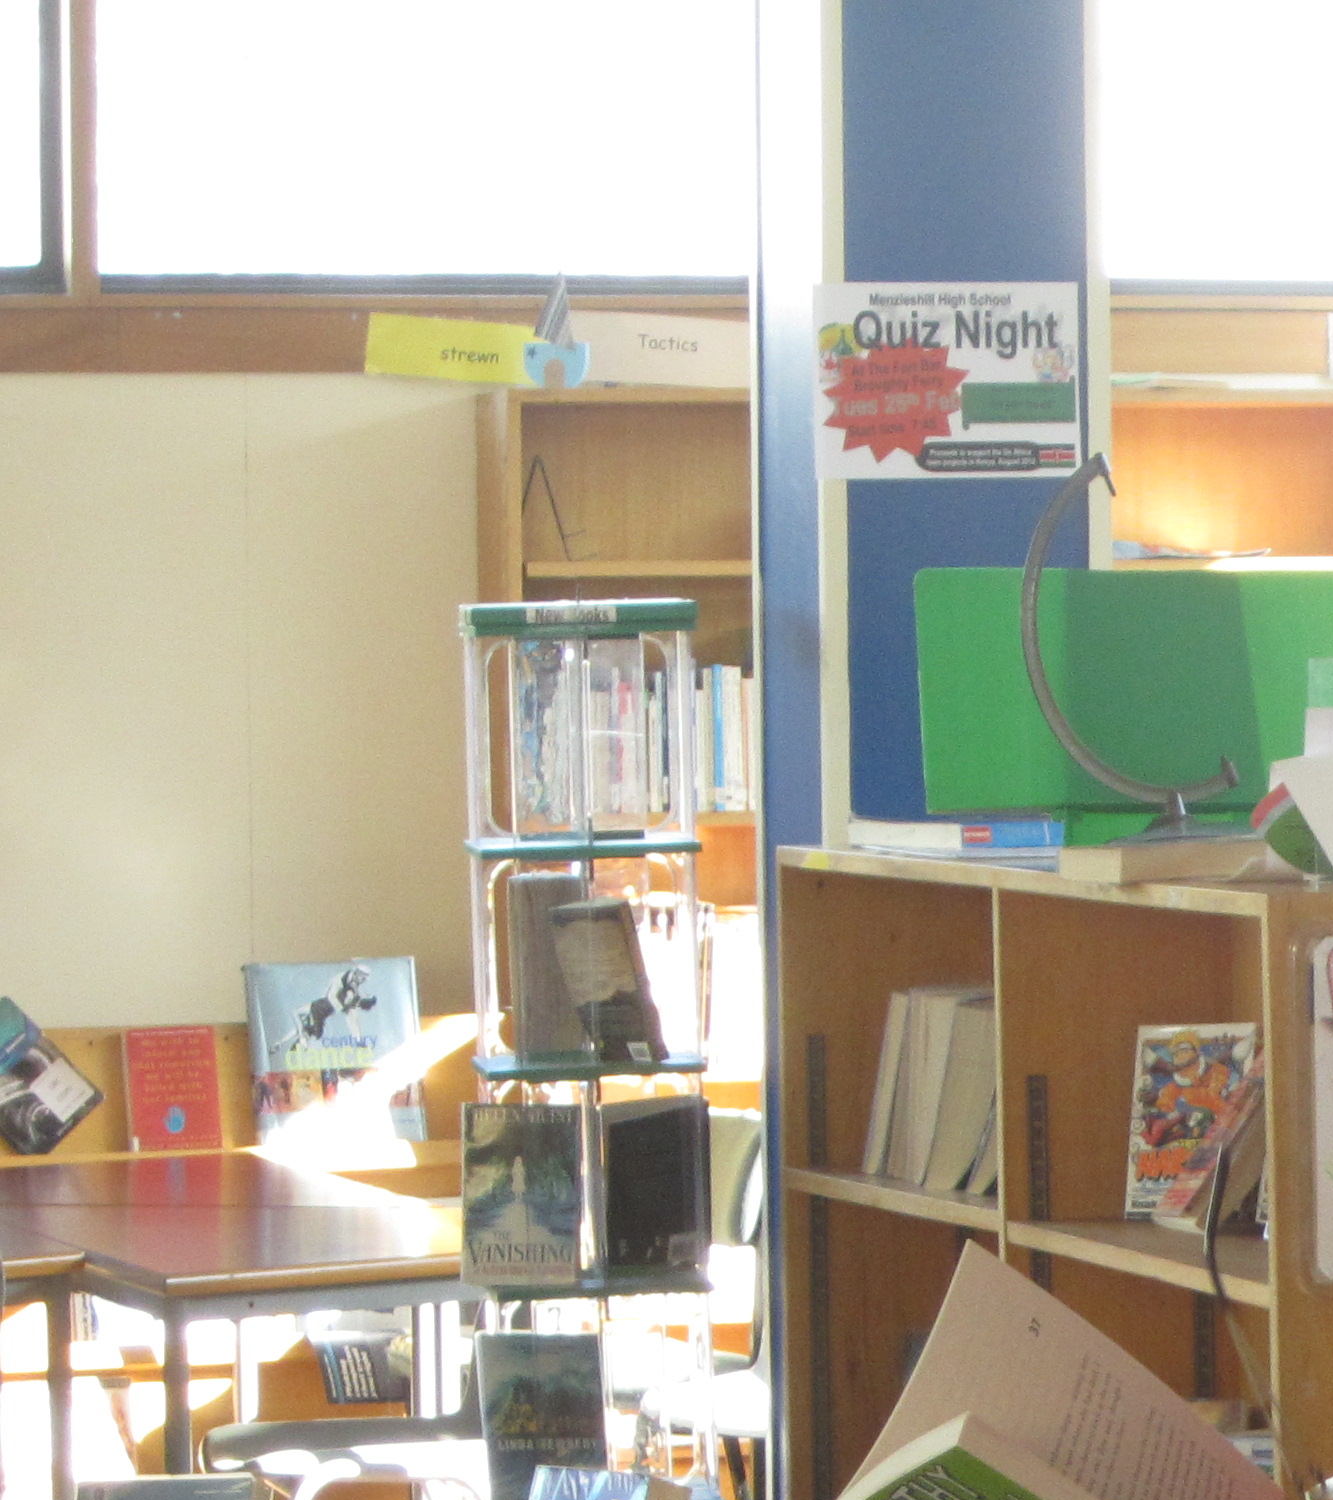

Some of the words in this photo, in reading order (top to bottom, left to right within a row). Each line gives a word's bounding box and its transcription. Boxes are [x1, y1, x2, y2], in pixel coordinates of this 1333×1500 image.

[938, 292, 966, 308] High
[969, 293, 1012, 306] School
[638, 333, 699, 353] Tactics
[853, 310, 942, 350] Quiz
[954, 309, 1059, 360] Night
[440, 347, 500, 364] strewn
[322, 1035, 377, 1048] century
[284, 1043, 376, 1070] dance
